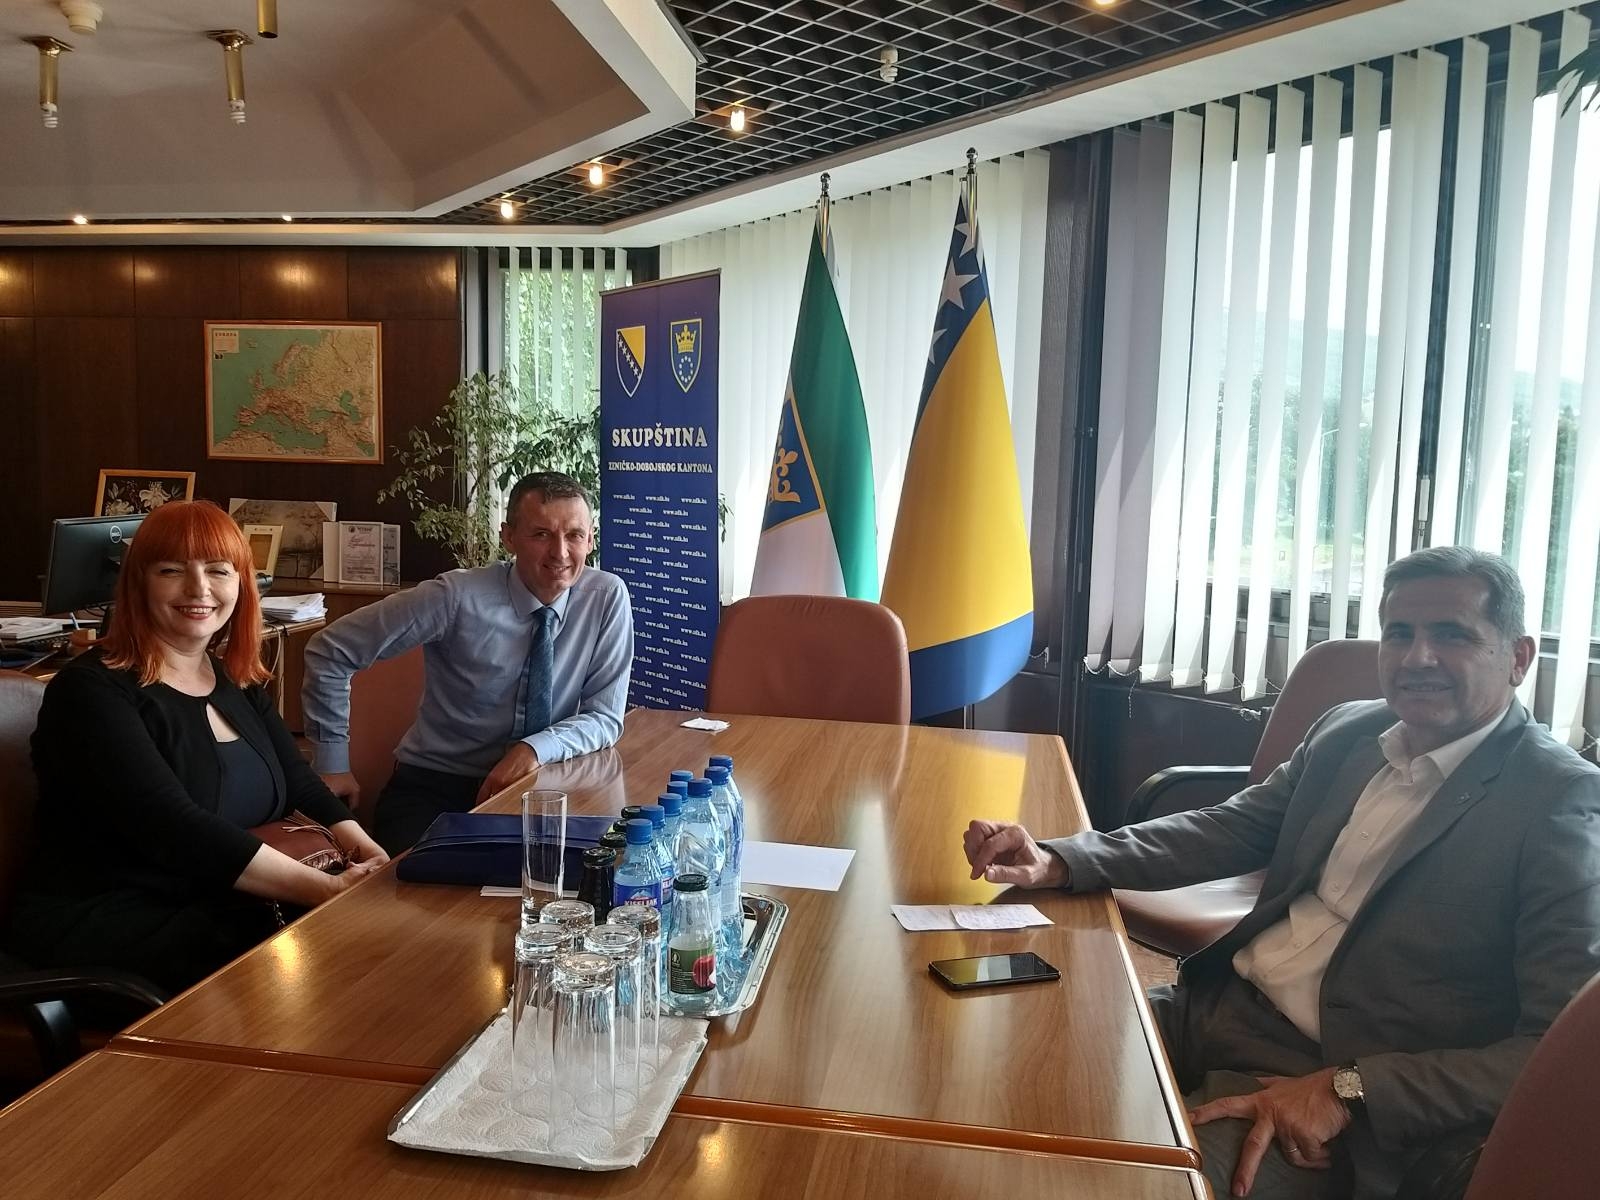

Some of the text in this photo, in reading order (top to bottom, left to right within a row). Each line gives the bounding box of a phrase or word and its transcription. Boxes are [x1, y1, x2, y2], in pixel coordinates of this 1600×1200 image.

[612, 422, 708, 447] SKUPŠTINA
[608, 460, 712, 473] ZENIČKO-DOBOJSKOG KANTONA
